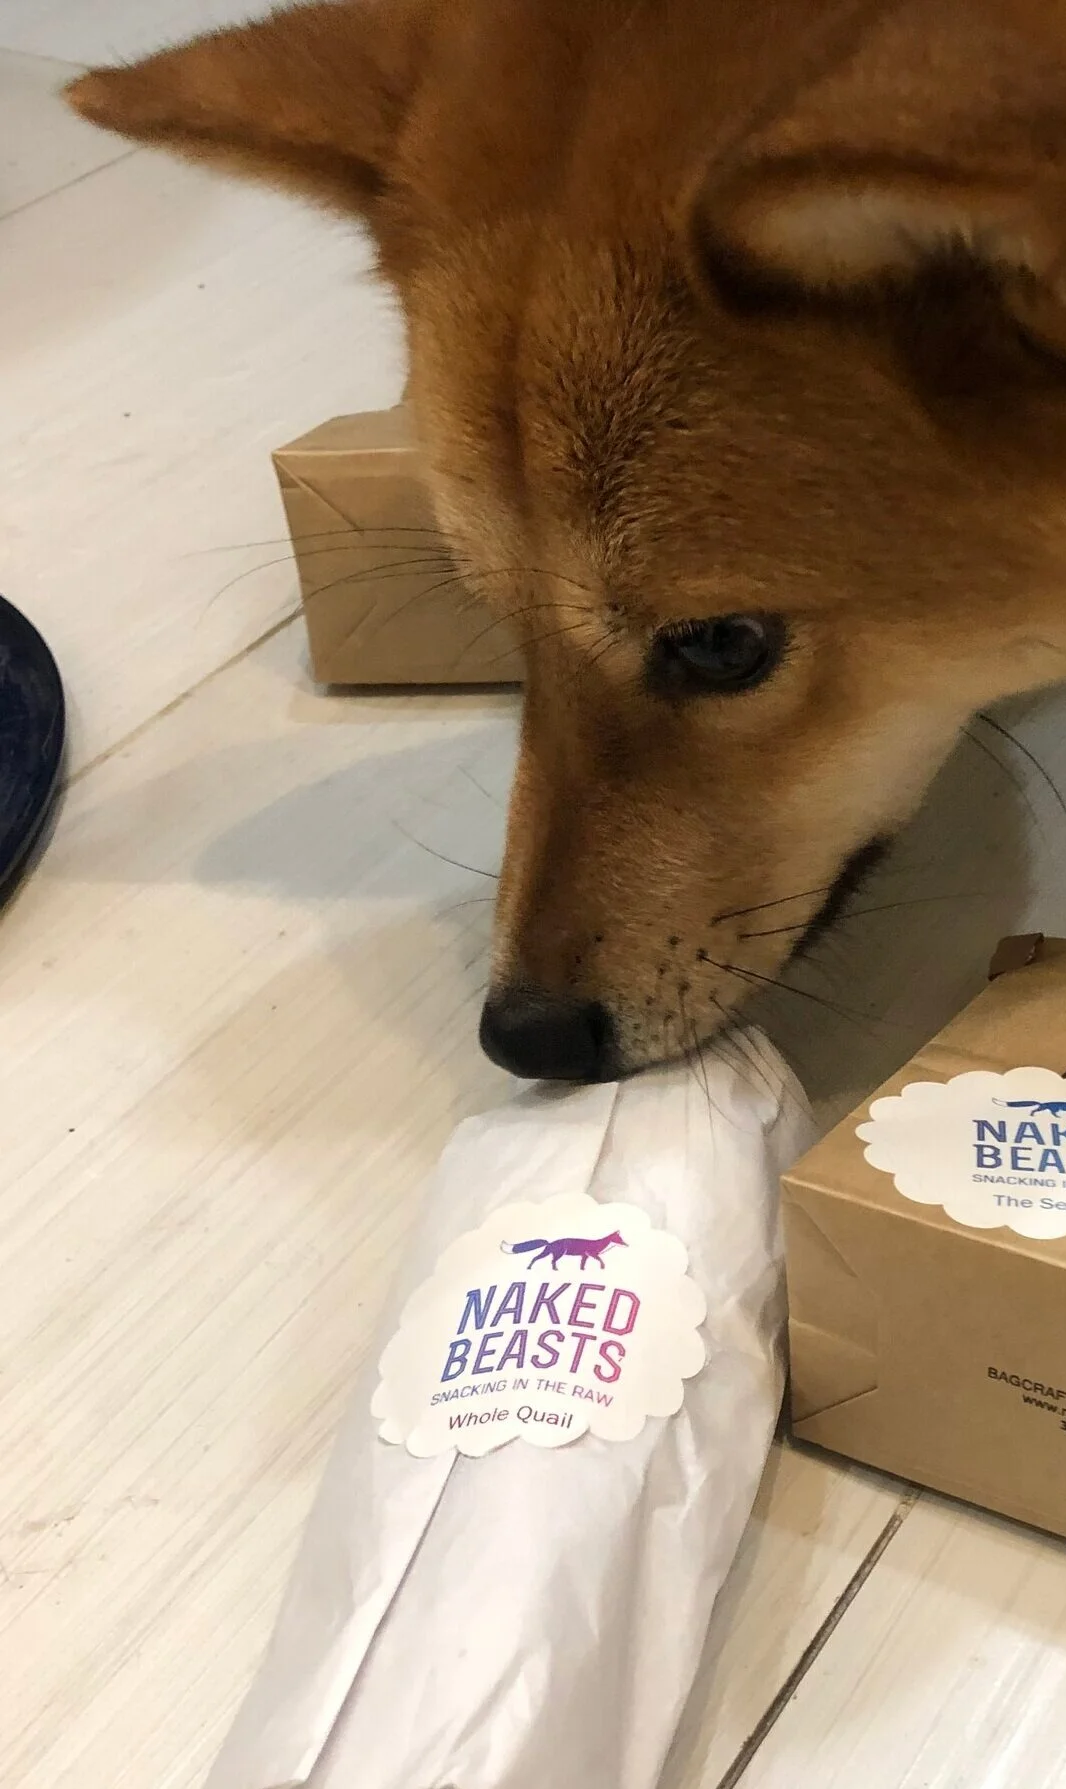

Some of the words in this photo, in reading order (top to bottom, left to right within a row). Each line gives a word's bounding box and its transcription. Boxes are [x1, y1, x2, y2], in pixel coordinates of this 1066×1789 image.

[972, 1173, 1057, 1189] SNACKING
[993, 1194, 1034, 1209] The
[456, 1281, 641, 1336] NAKED
[440, 1329, 626, 1384] BEASTS
[430, 1379, 507, 1407] SNACKING
[512, 1378, 529, 1391] IN
[536, 1379, 566, 1394] THE
[571, 1384, 615, 1408] RAW
[448, 1407, 510, 1431] Whole
[515, 1404, 574, 1430] Quail
